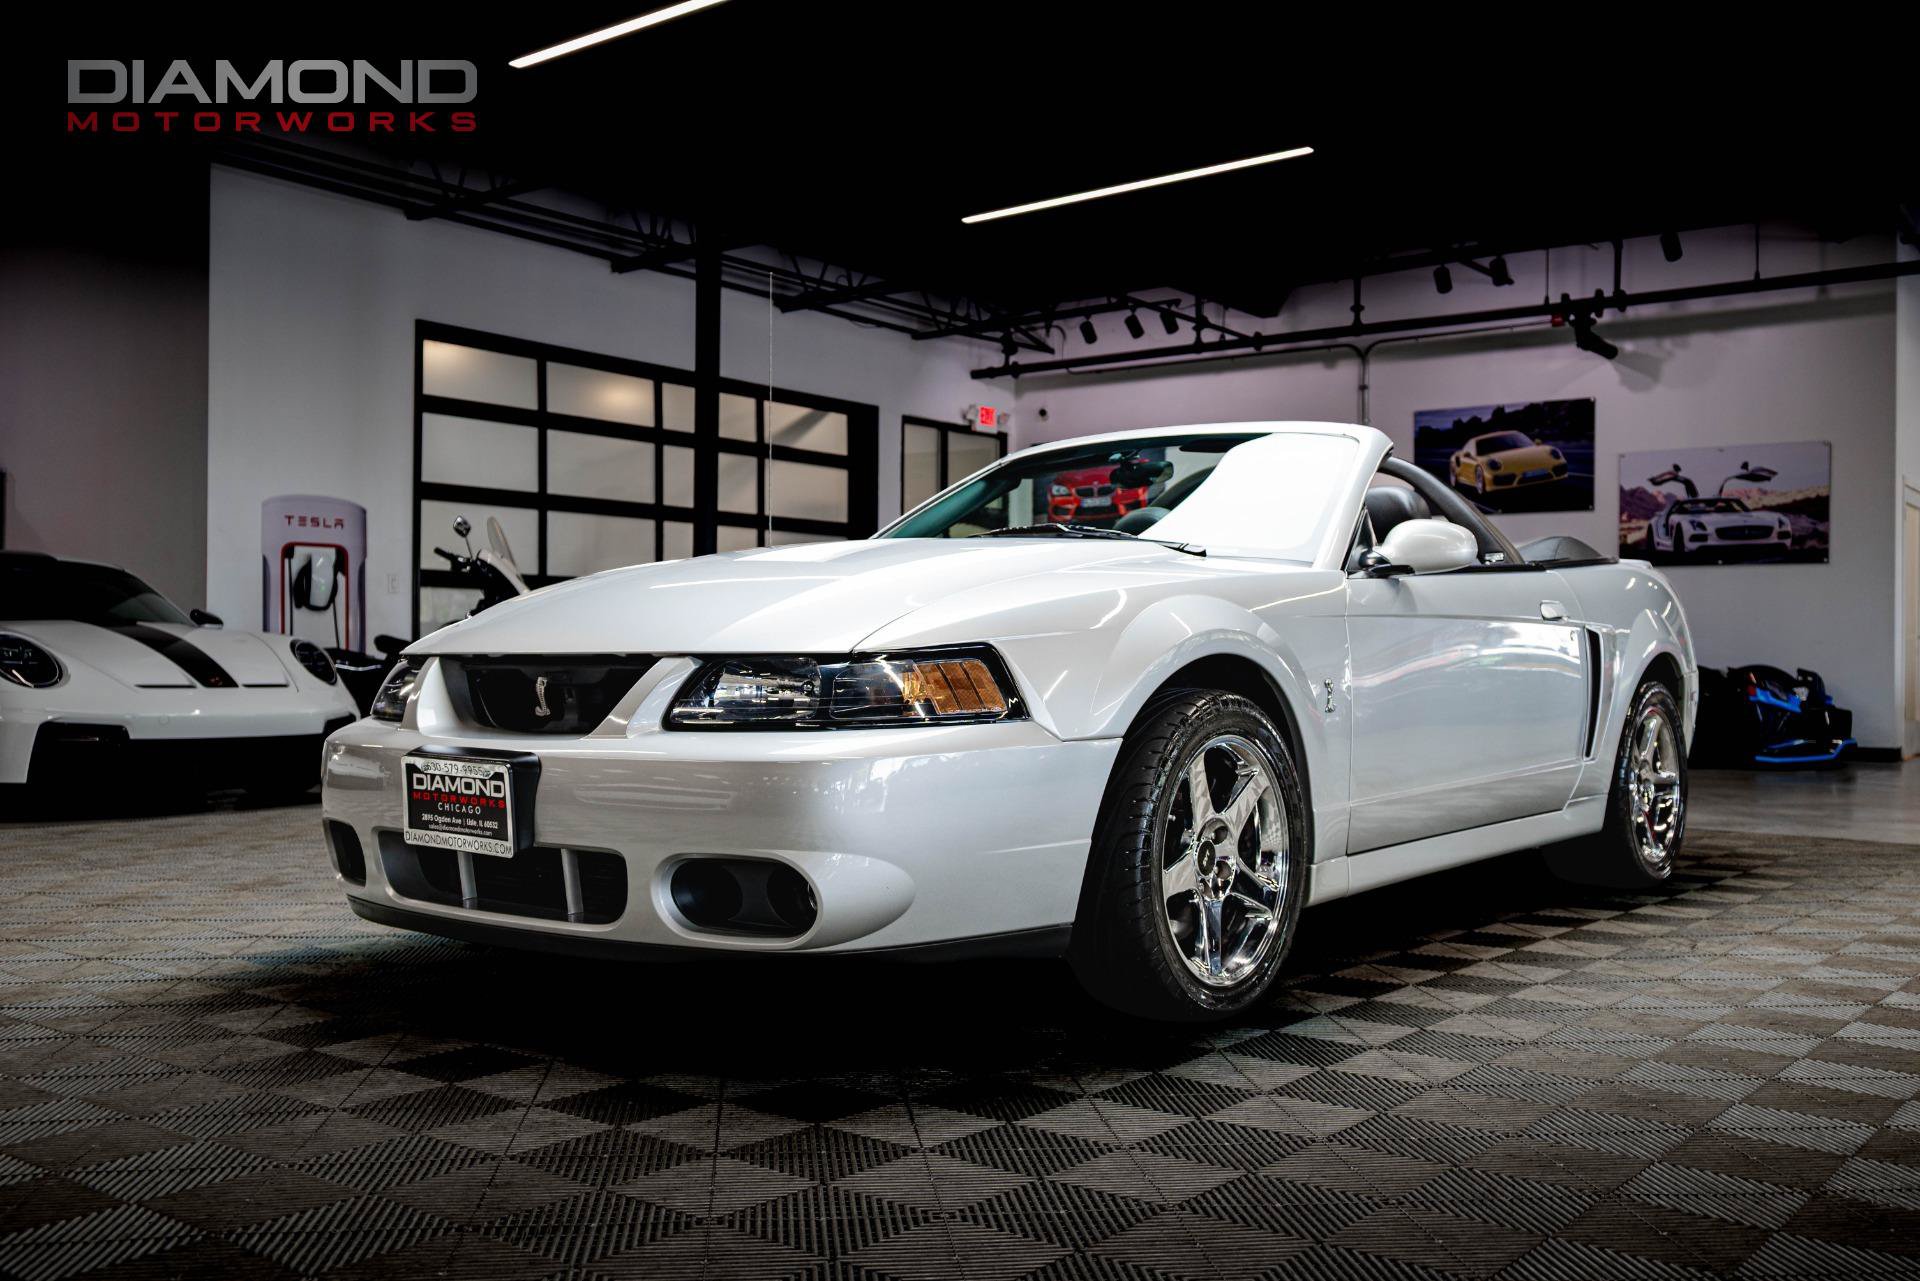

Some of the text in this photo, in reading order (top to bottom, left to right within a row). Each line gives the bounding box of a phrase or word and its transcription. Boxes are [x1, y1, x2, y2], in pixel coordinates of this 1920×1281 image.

[284, 514, 345, 529] TESLA
[412, 772, 505, 798] DIAMOND
[412, 791, 505, 809] MOTORWORKS
[437, 803, 481, 815] CHICAGO
[434, 814, 451, 824] Ogden
[452, 816, 462, 824] Ave
[405, 831, 512, 856] DIAMONDMOTORWORKS.COM
